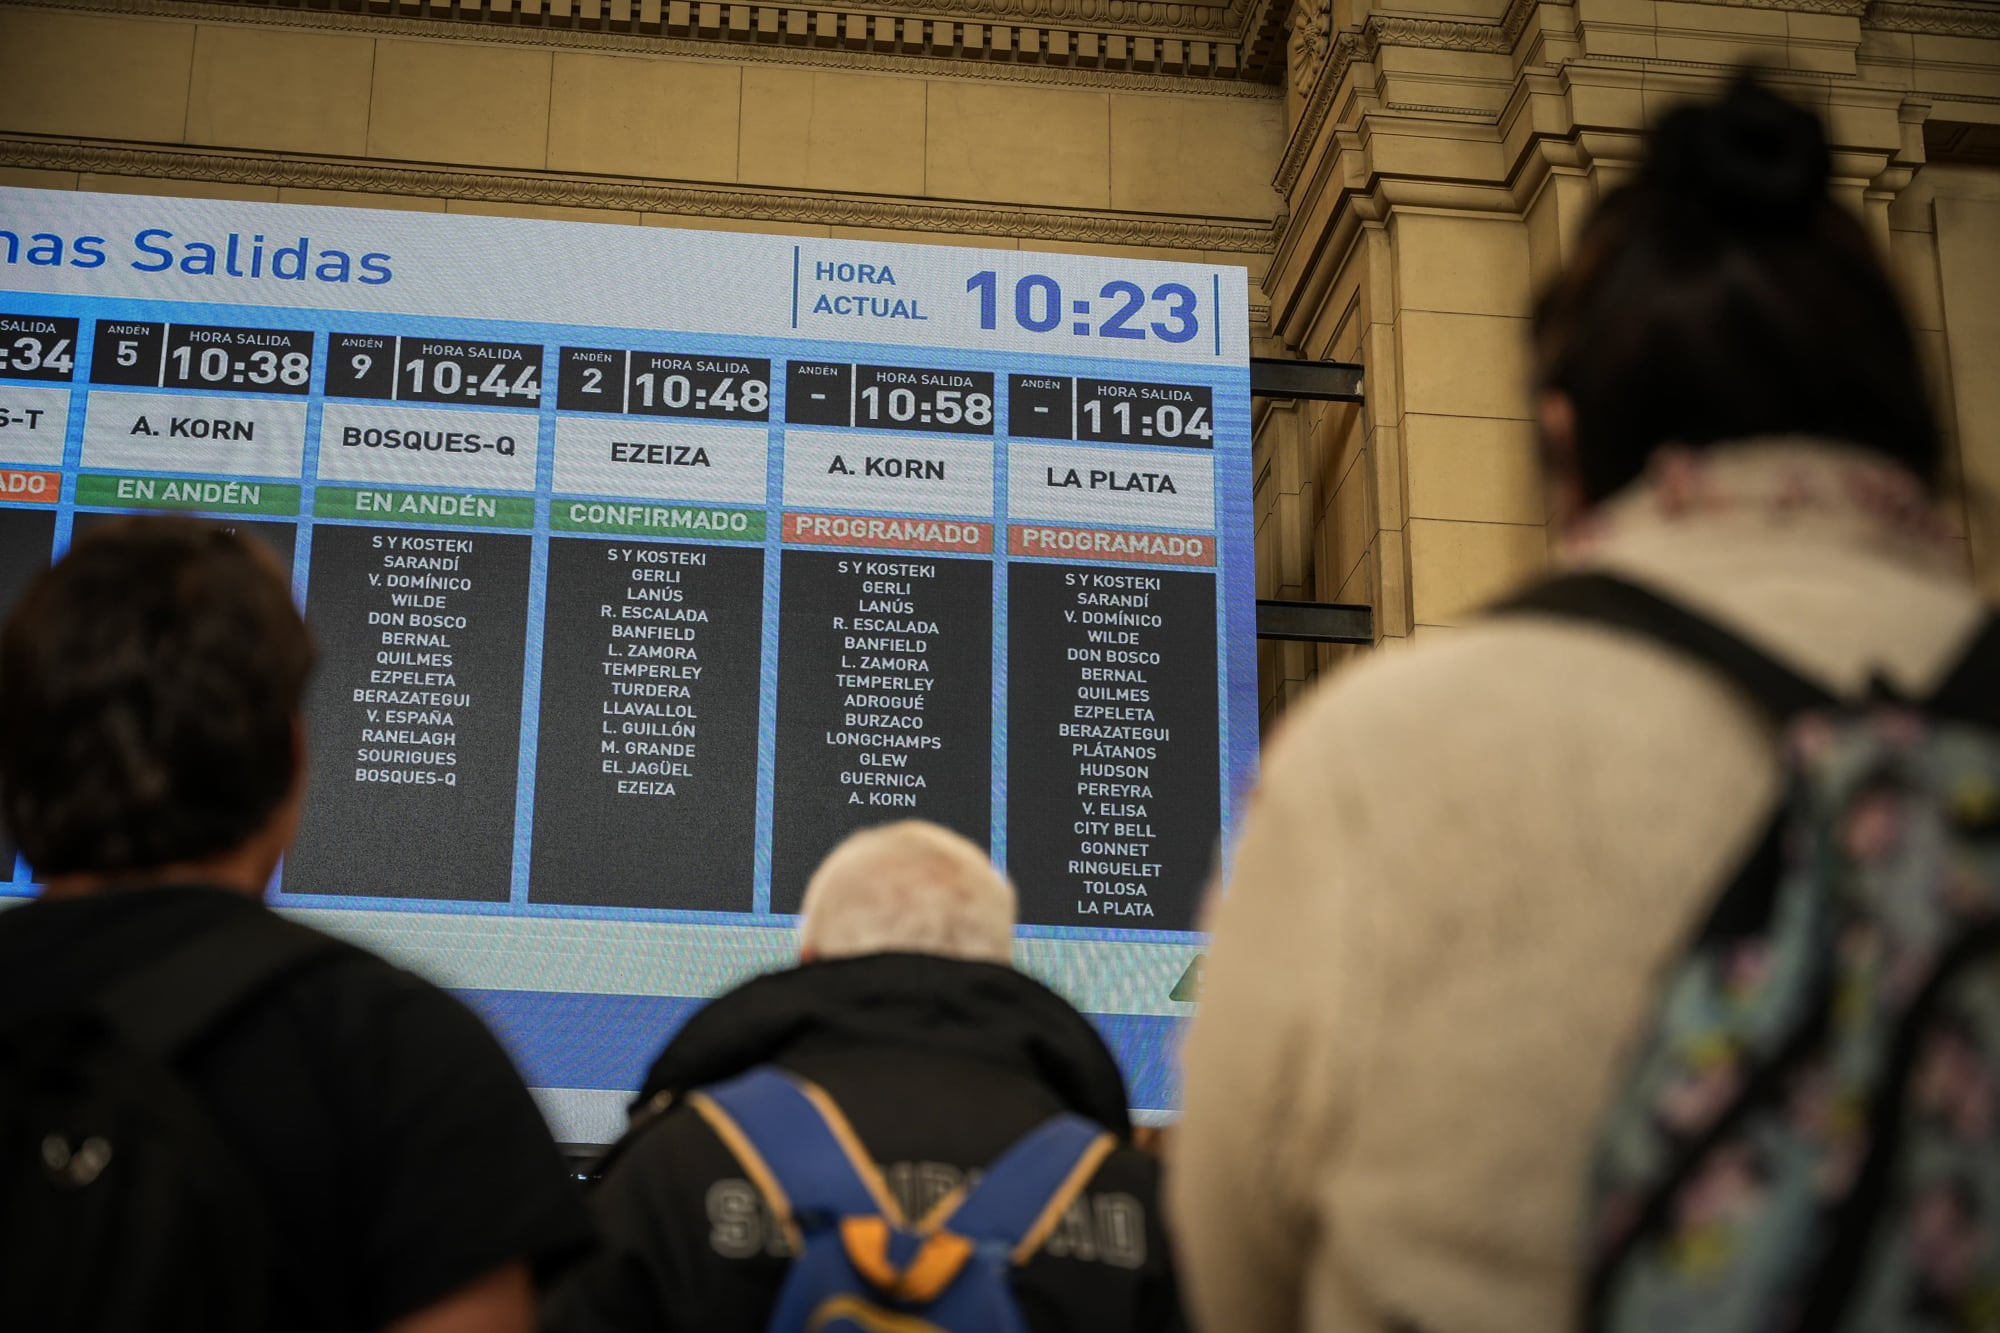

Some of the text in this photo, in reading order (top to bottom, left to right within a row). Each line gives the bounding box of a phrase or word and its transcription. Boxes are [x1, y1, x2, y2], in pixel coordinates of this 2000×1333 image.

[131, 228, 393, 285] Salidas
[815, 260, 897, 286] HORA
[813, 293, 928, 321] ACTUAL
[965, 270, 1199, 344] 10:23
[0, 319, 57, 334] SALIDA
[106, 325, 150, 336] ANDÉN
[189, 331, 291, 347] HORA SALIDA
[341, 338, 383, 349] ANDÉN
[116, 340, 139, 367] 5
[422, 344, 523, 361] HORA SALIDA
[571, 352, 612, 363] ANDÉN
[172, 345, 310, 386] 10:38
[351, 353, 373, 379] 9
[651, 358, 750, 374] HORA SALIDA
[798, 365, 838, 377] ANDÉN
[405, 358, 541, 400] 10:44
[581, 367, 603, 394] 2
[876, 371, 974, 388] HORA SALIDA
[1021, 379, 1061, 390] ANDÉN
[635, 372, 769, 413] 10:48
[1097, 385, 1193, 402] HORA SALIDA
[861, 386, 993, 426] 10:58
[130, 415, 254, 441] A. KORN
[1083, 399, 1214, 440] 11:04
[342, 426, 516, 457] BOSQUES-Q
[611, 441, 711, 467] EZEIZA
[827, 455, 945, 481] A. KORN
[1046, 467, 1178, 495] LA PLATA
[117, 479, 261, 505] EN ANDÉN
[355, 491, 497, 518] EN ANDÉN
[569, 503, 748, 532] CONFIRMADO
[795, 516, 980, 545] PROGRAMADO
[372, 535, 473, 553] S Y KOSTEKI
[1022, 528, 1203, 558] PROGRAMADO
[383, 555, 461, 571] SARANDÍ
[607, 548, 706, 566] S Y KOSTEKI
[631, 568, 681, 583] GERLI
[838, 561, 936, 579] S Y KOSTEKI
[368, 572, 472, 591] V. DOMÍNICO
[862, 580, 911, 595] GERLI
[1065, 573, 1161, 591] S Y KOSTEKI
[391, 593, 447, 609] WILDE
[627, 586, 684, 602] LANÚS
[1077, 592, 1149, 608] SARANDÍ
[601, 604, 709, 622] R. ESCALADA
[859, 598, 915, 614] LANÚS
[368, 612, 467, 629] DON BOSCO
[833, 617, 940, 635] R. ESCALADA
[1064, 609, 1162, 627] V. DOMÍNICO
[382, 631, 451, 648] BERNAL
[611, 624, 696, 641] BANFIELD
[1087, 630, 1140, 645] WILDE
[608, 643, 698, 660] L. ZAMORA
[844, 636, 927, 653] BANFIELD
[377, 651, 453, 667] QUILMES
[841, 655, 929, 672] L. ZAMORA
[1067, 648, 1160, 665] DON BOSCO
[370, 670, 456, 687] EZPELETA
[601, 662, 703, 680] TEMPERLEY
[1081, 667, 1147, 683] BERNAL
[611, 682, 691, 699] TURDERA
[835, 674, 934, 692] TEMPERLEY
[353, 689, 470, 707] BERAZATEGUI
[843, 694, 925, 710] ADROGUÉ
[1077, 686, 1150, 702] QUILMES
[366, 709, 455, 726] V. ESPAÑA
[603, 701, 697, 719] LLAVALLOL
[1074, 705, 1155, 722] EZPELETA
[603, 720, 696, 738] L. GUILLÓN
[845, 713, 924, 729] BURZACO
[361, 729, 456, 746] RANELAGH
[826, 731, 942, 749] LONGCHAMPS
[1059, 722, 1170, 741] BERAZATEGUI
[357, 748, 457, 766] SOURIGUES
[601, 740, 696, 758] M. GRANDE
[1072, 741, 1157, 760] PLÁTANOS
[602, 759, 693, 777] EL JAGÜEL
[859, 753, 909, 768] GLEW
[355, 768, 457, 787] BOSQUES-Q
[840, 771, 927, 788] GUERNICA
[1080, 763, 1149, 779] HUDSON
[617, 780, 676, 796] EZEIZA
[1077, 782, 1153, 798] PEREYRA
[848, 791, 917, 807] A. KORN
[1082, 801, 1148, 818] V. ELISA
[1074, 821, 1156, 838] CITY BELL
[1081, 841, 1150, 857] GONNET
[1068, 860, 1163, 877] RINGUELET
[1083, 880, 1148, 896] TOLOSA
[1077, 900, 1155, 917] LA PLATA
